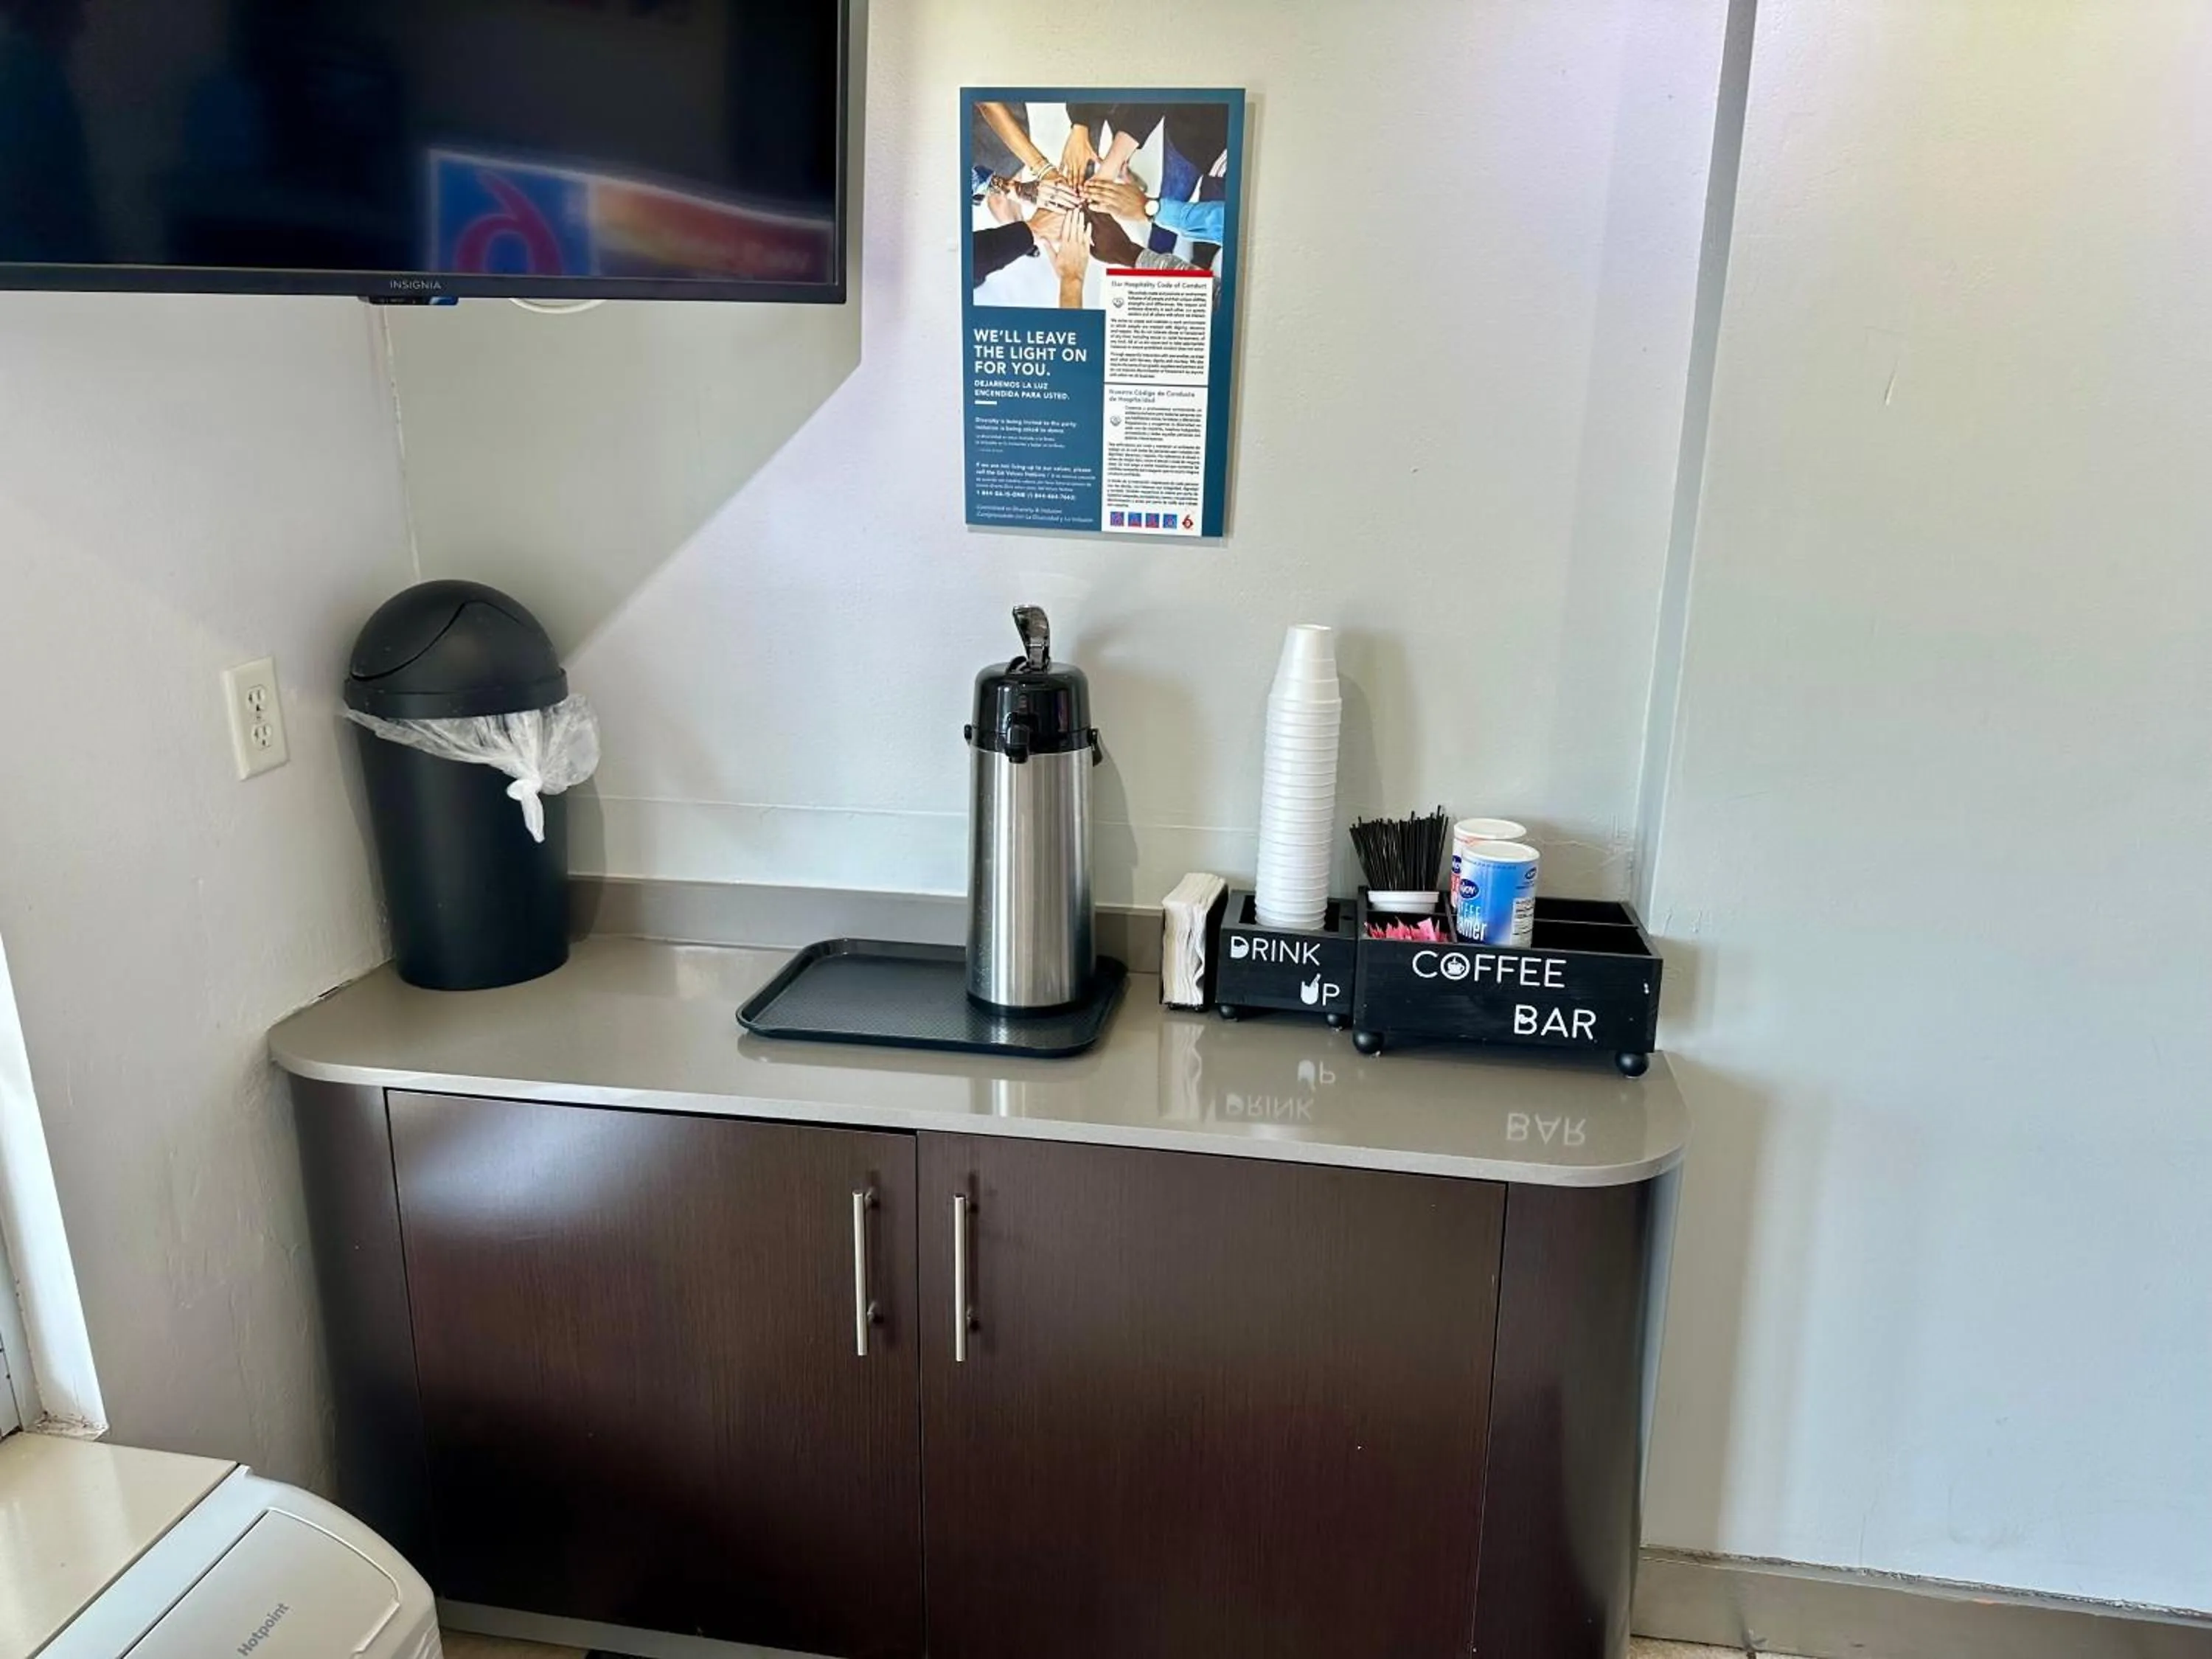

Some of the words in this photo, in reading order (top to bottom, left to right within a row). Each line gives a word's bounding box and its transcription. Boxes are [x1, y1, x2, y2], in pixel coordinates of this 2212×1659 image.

[389, 279, 442, 290] INSIGNIA
[973, 328, 1021, 343] WE'LL
[1027, 331, 1077, 345] LEAVE
[974, 345, 1005, 359] THE
[1010, 347, 1057, 361] LIGHT
[1062, 348, 1087, 362] ON
[975, 361, 1006, 375] FOR
[1012, 362, 1051, 376] YOU.
[974, 380, 1020, 389] DEJAREMOS
[1034, 382, 1048, 390] LUZ
[974, 389, 1020, 398] ENCENDIDA
[1021, 391, 1041, 399] PARA
[1230, 935, 1321, 967] DRINK
[1412, 950, 1567, 988] COFFEE
[1300, 973, 1341, 1006] UP
[1514, 1004, 1597, 1040] BAR
[237, 1602, 290, 1657] Hotpoint
